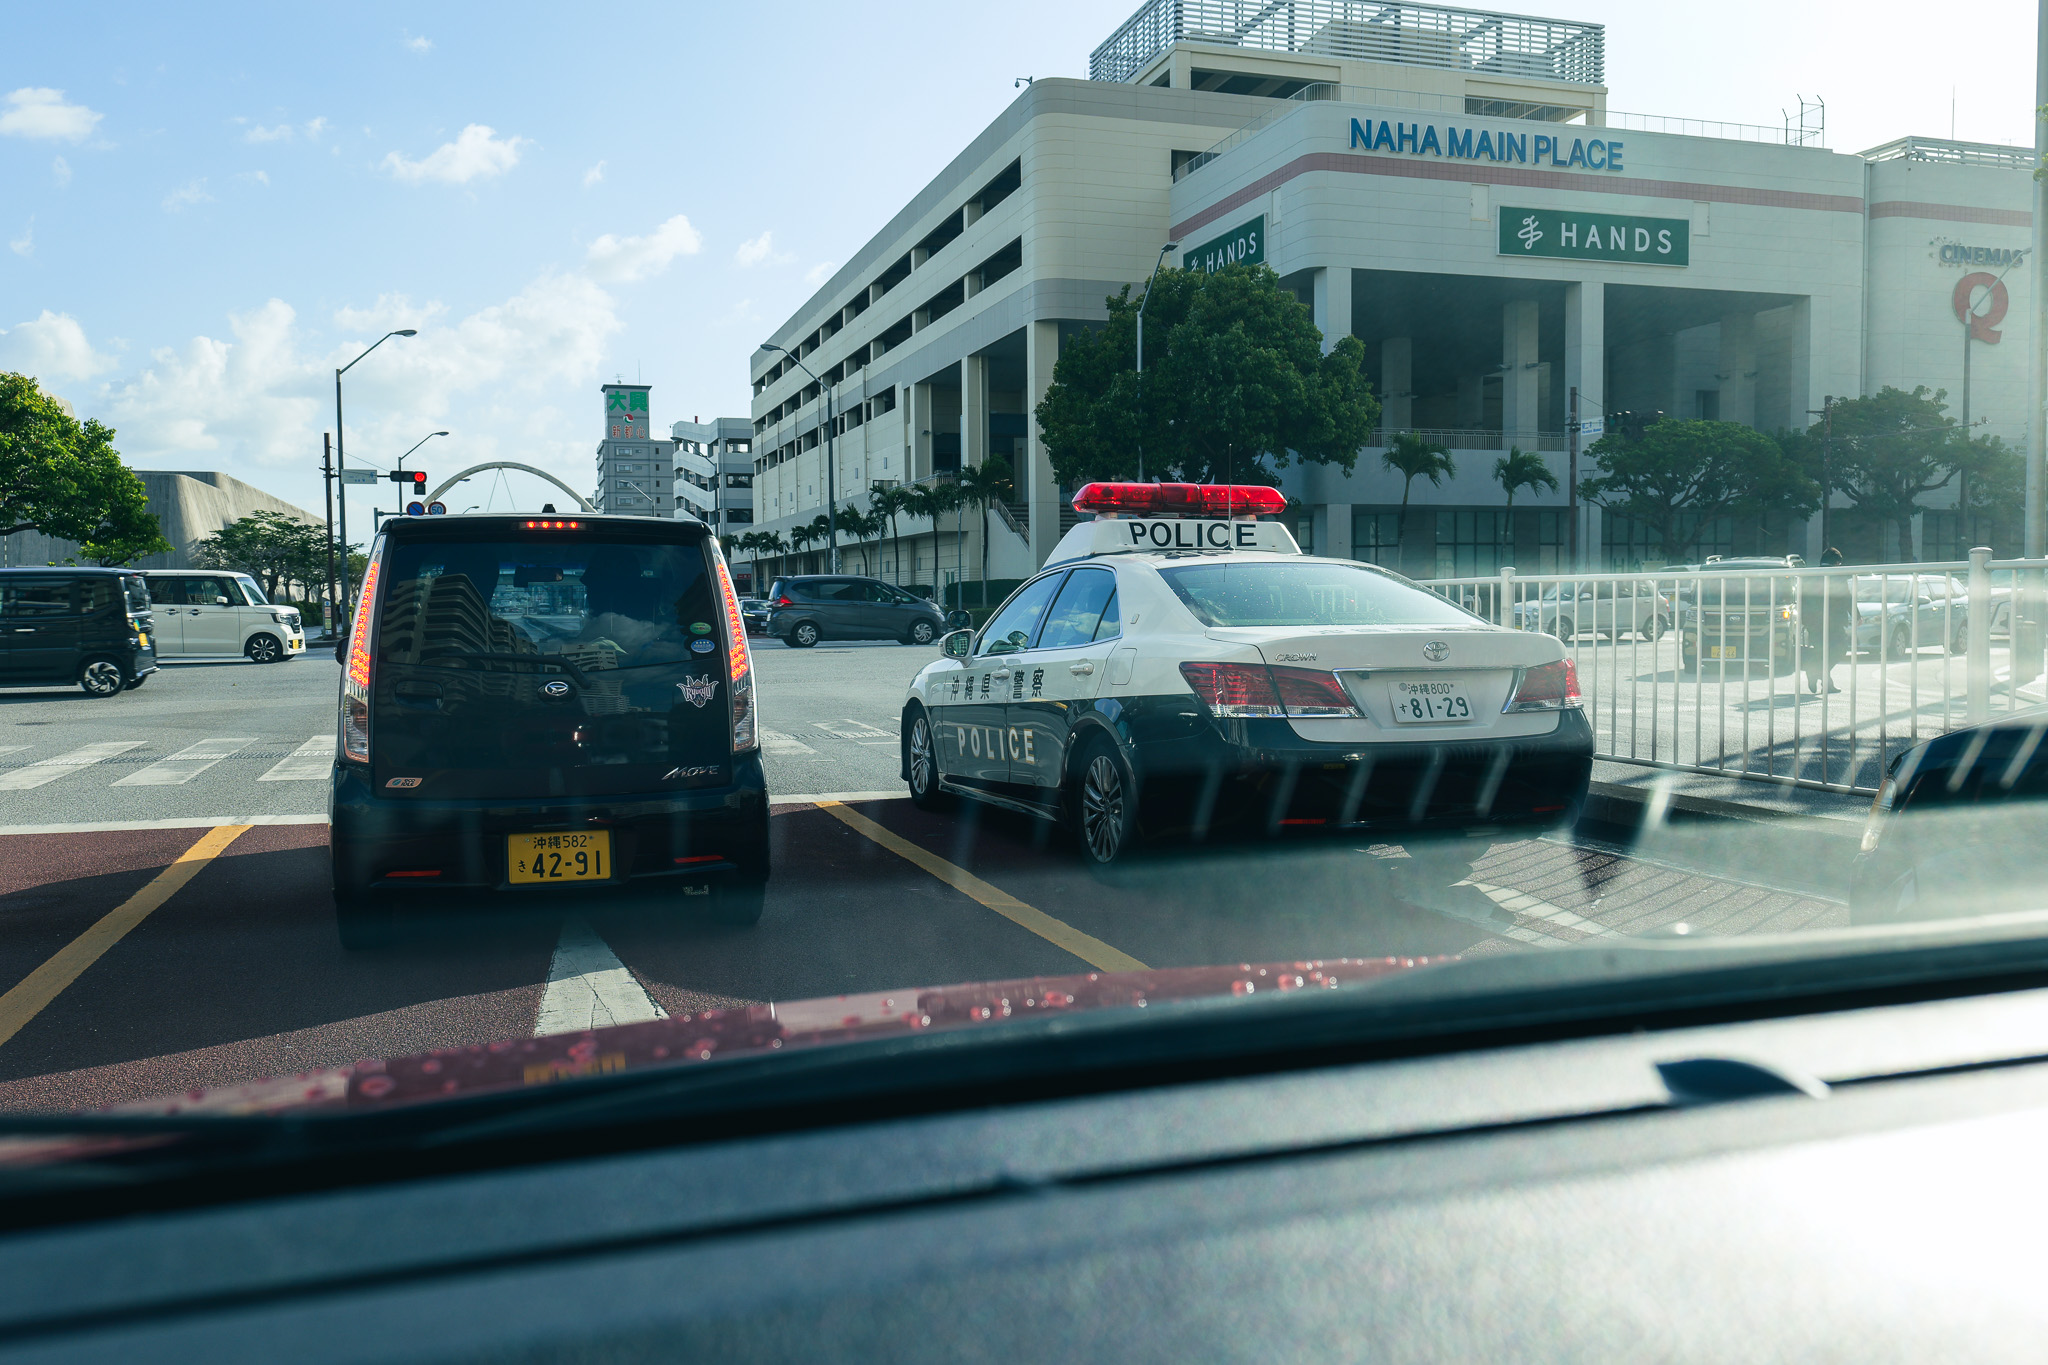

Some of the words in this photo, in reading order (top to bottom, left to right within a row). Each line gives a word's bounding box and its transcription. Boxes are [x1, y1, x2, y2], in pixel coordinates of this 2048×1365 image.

[1350, 117, 1442, 156] NAHA
[1447, 126, 1527, 164] MAIN
[1532, 134, 1624, 172] PLACE
[1560, 222, 1672, 254] HANDS
[1205, 231, 1257, 274] HANDS
[1940, 244, 2024, 268] CINEMAS
[1952, 271, 2009, 345] Q
[608, 390, 648, 412] 大興
[612, 425, 646, 439] 新都心
[431, 506, 443, 515] 50
[1128, 522, 1257, 548] POLICE
[1275, 652, 1317, 662] CROWN
[1410, 697, 1469, 719] 81-29
[957, 726, 1035, 764] POLICE
[661, 765, 720, 780] MOVE
[532, 850, 601, 878] 42-91
